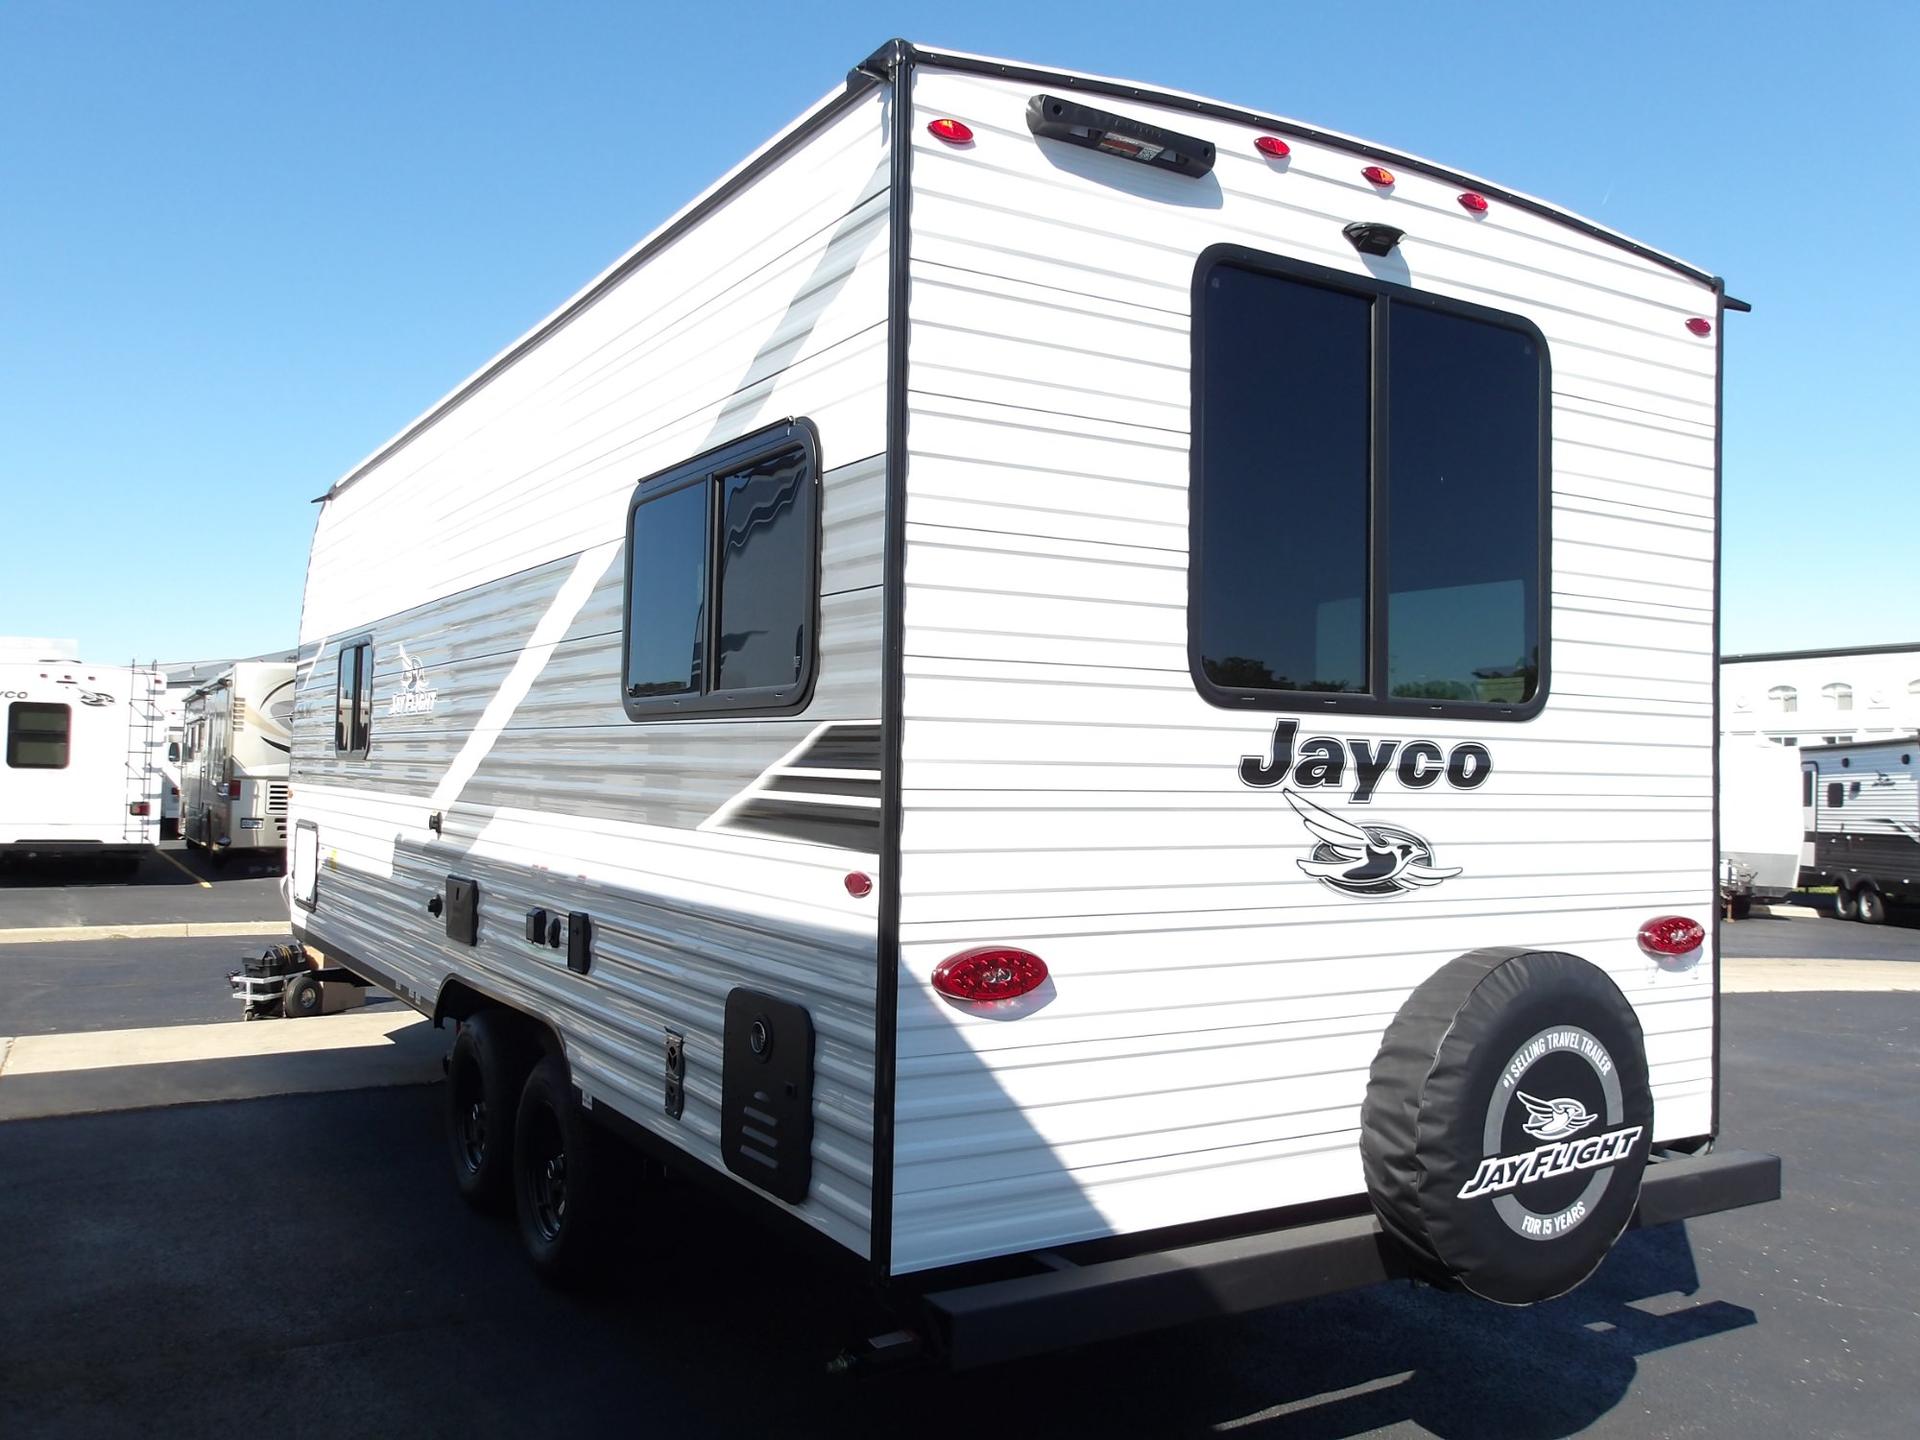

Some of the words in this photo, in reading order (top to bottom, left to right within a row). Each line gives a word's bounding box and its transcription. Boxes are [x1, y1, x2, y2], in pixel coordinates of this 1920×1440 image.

[1238, 717, 1493, 804] Jayco
[1502, 1073, 1515, 1089] #1
[1510, 1037, 1546, 1078] SELLING
[1546, 1031, 1579, 1050] TRAVEL
[1580, 1036, 1612, 1076] TRAILER
[1521, 1215, 1540, 1235] FOR
[1542, 1218, 1553, 1235] 15
[1554, 1201, 1586, 1232] YEARS
